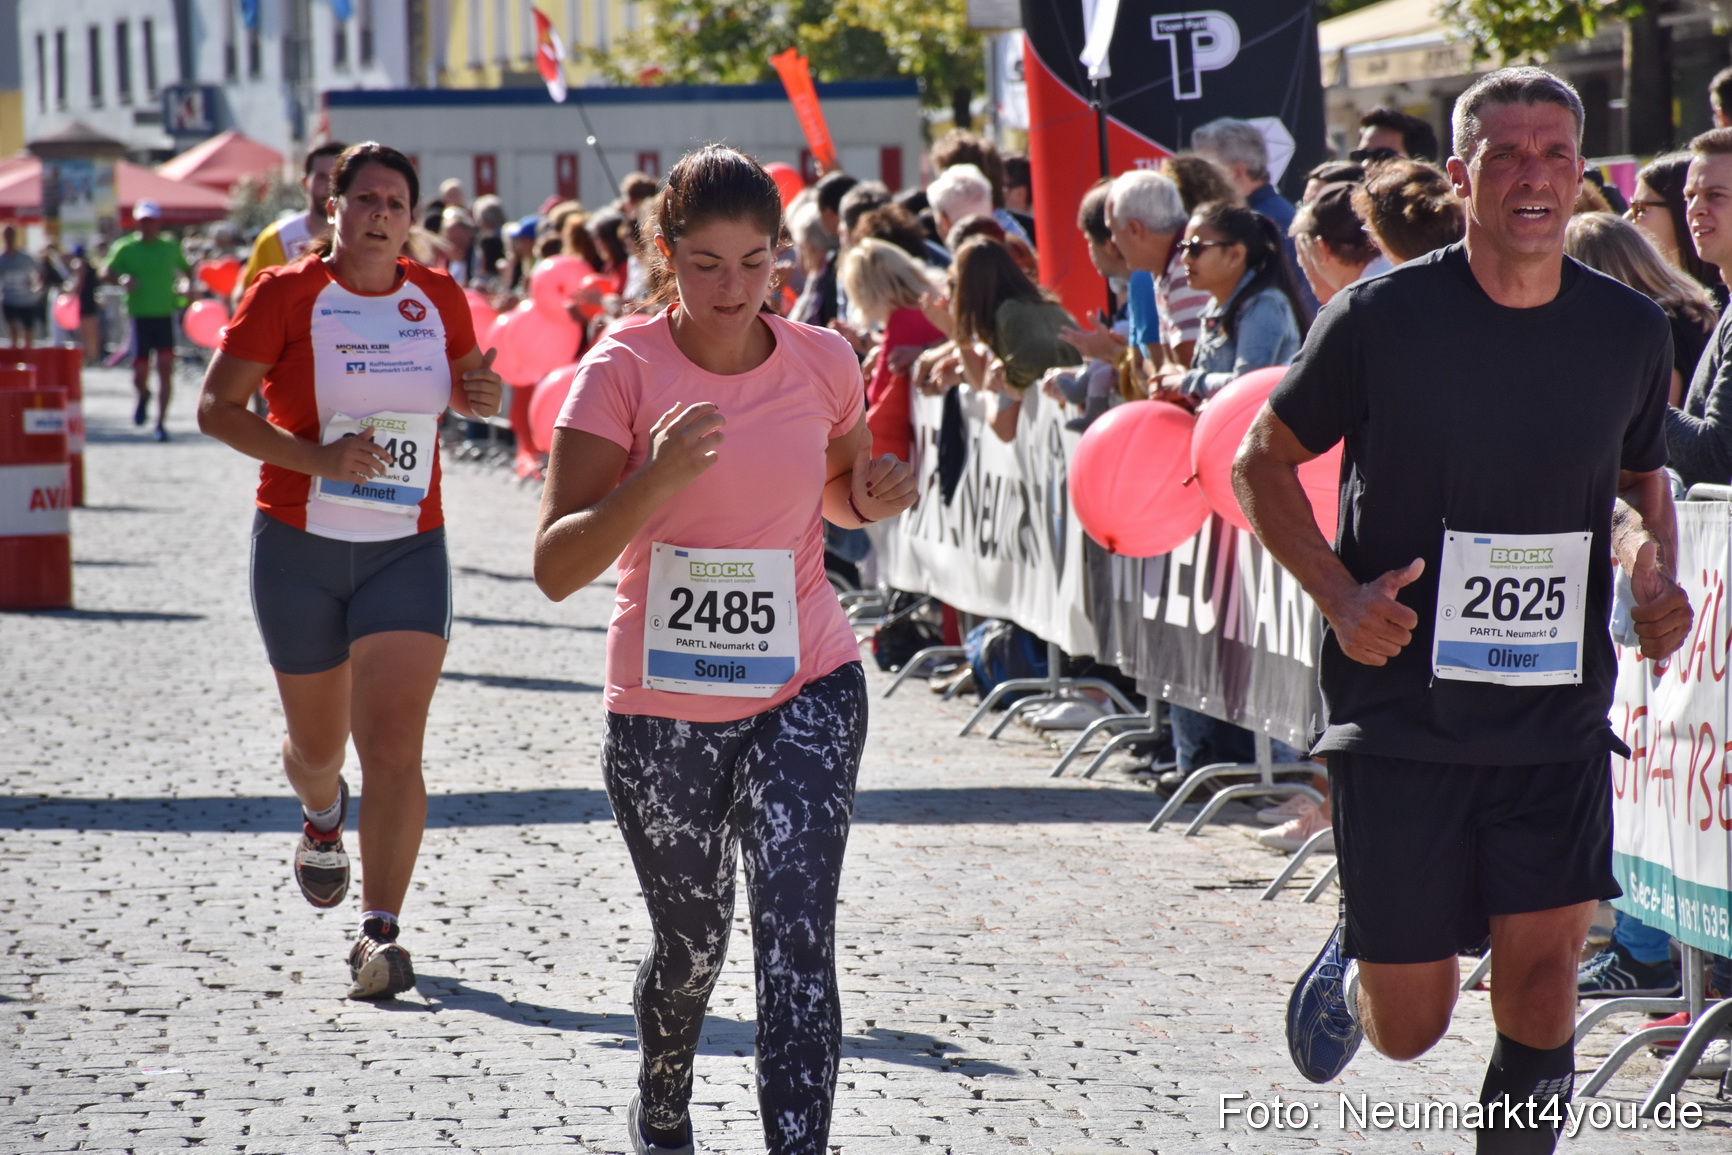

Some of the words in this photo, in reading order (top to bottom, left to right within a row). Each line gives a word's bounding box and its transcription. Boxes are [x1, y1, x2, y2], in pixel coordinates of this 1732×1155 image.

[398, 329, 437, 338] KOPPE
[352, 484, 396, 500] Annett
[1490, 548, 1554, 564] BOCK
[690, 562, 755, 577] BOCK
[1461, 576, 1566, 622] 2625
[668, 587, 775, 634] 2485
[1469, 627, 1503, 638] PARTL
[1506, 629, 1547, 638] Neumarkt
[676, 638, 707, 649] PARTL
[709, 641, 755, 651] Neumarkt
[1487, 648, 1539, 668] Oliver
[694, 659, 746, 682] Sonja
